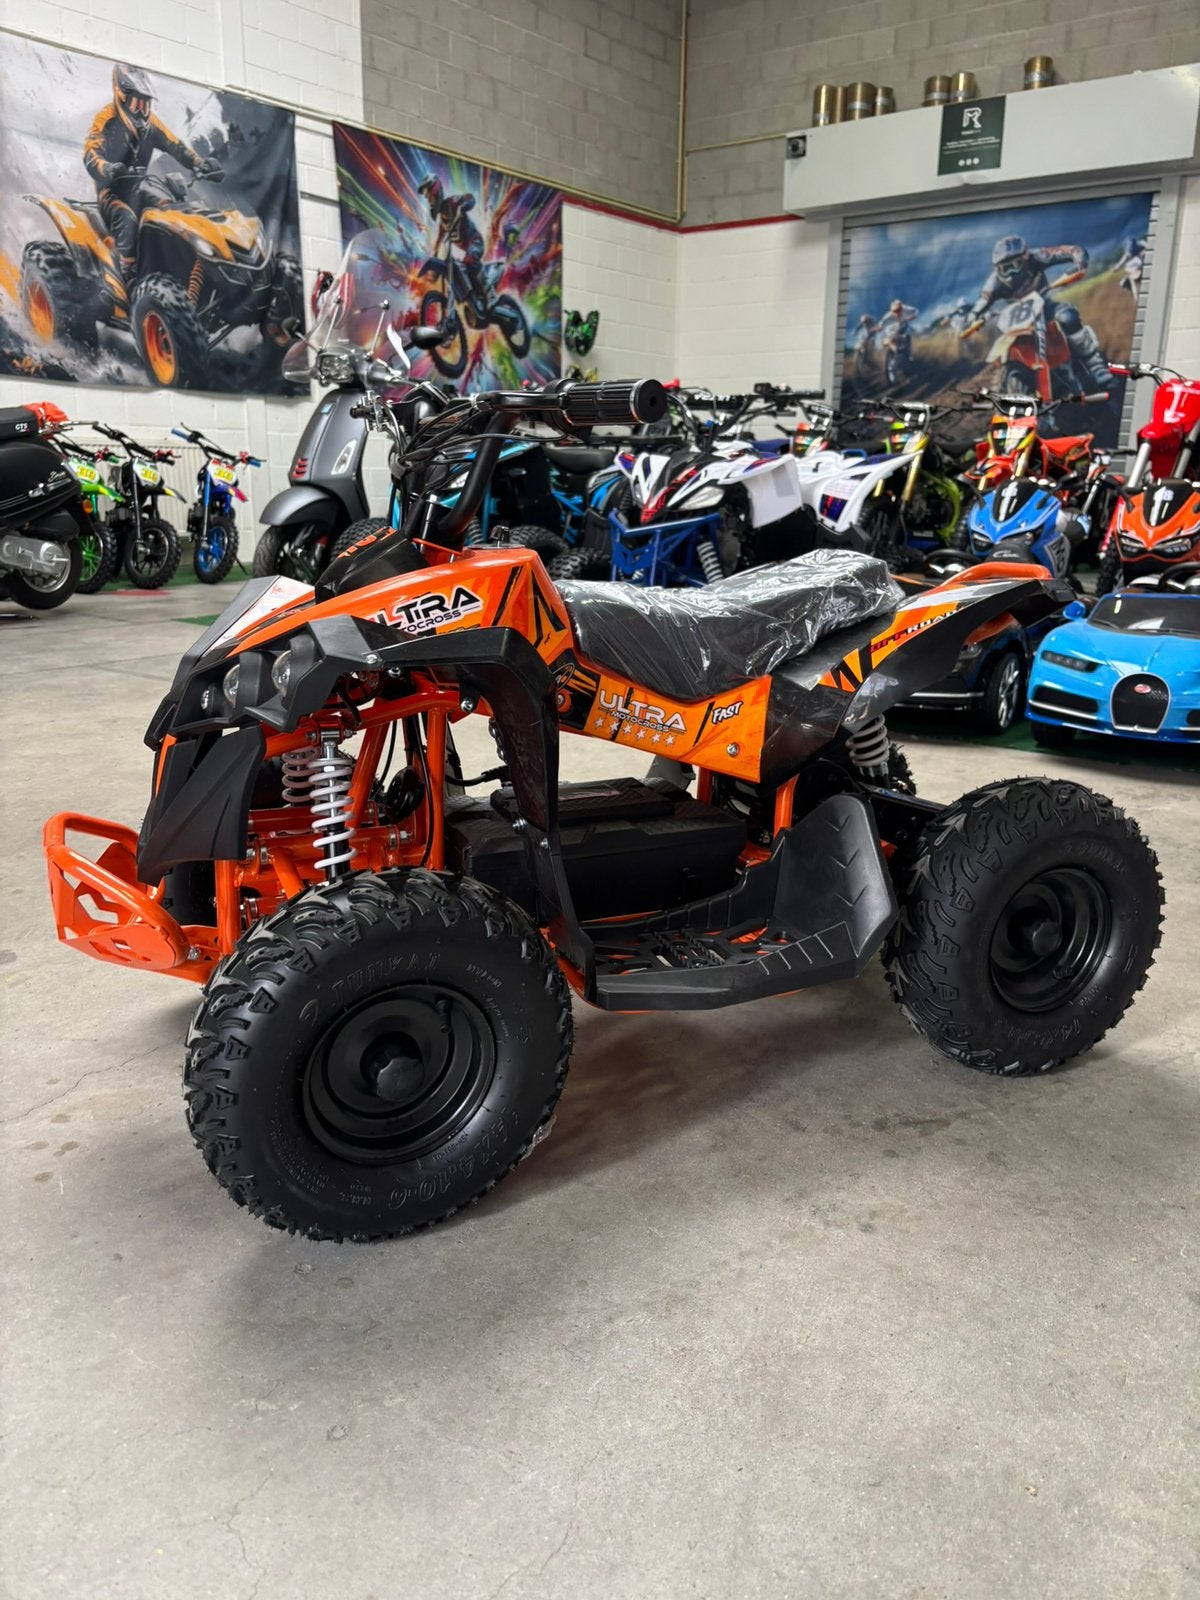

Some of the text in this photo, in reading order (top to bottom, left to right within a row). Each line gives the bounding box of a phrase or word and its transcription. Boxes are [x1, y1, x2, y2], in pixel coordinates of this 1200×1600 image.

[15, 423, 28, 431] GTS
[372, 588, 481, 629] LTRA
[600, 689, 687, 732] ULTRA
[611, 710, 671, 734] MOTOCROSS
[712, 701, 744, 725] FAST
